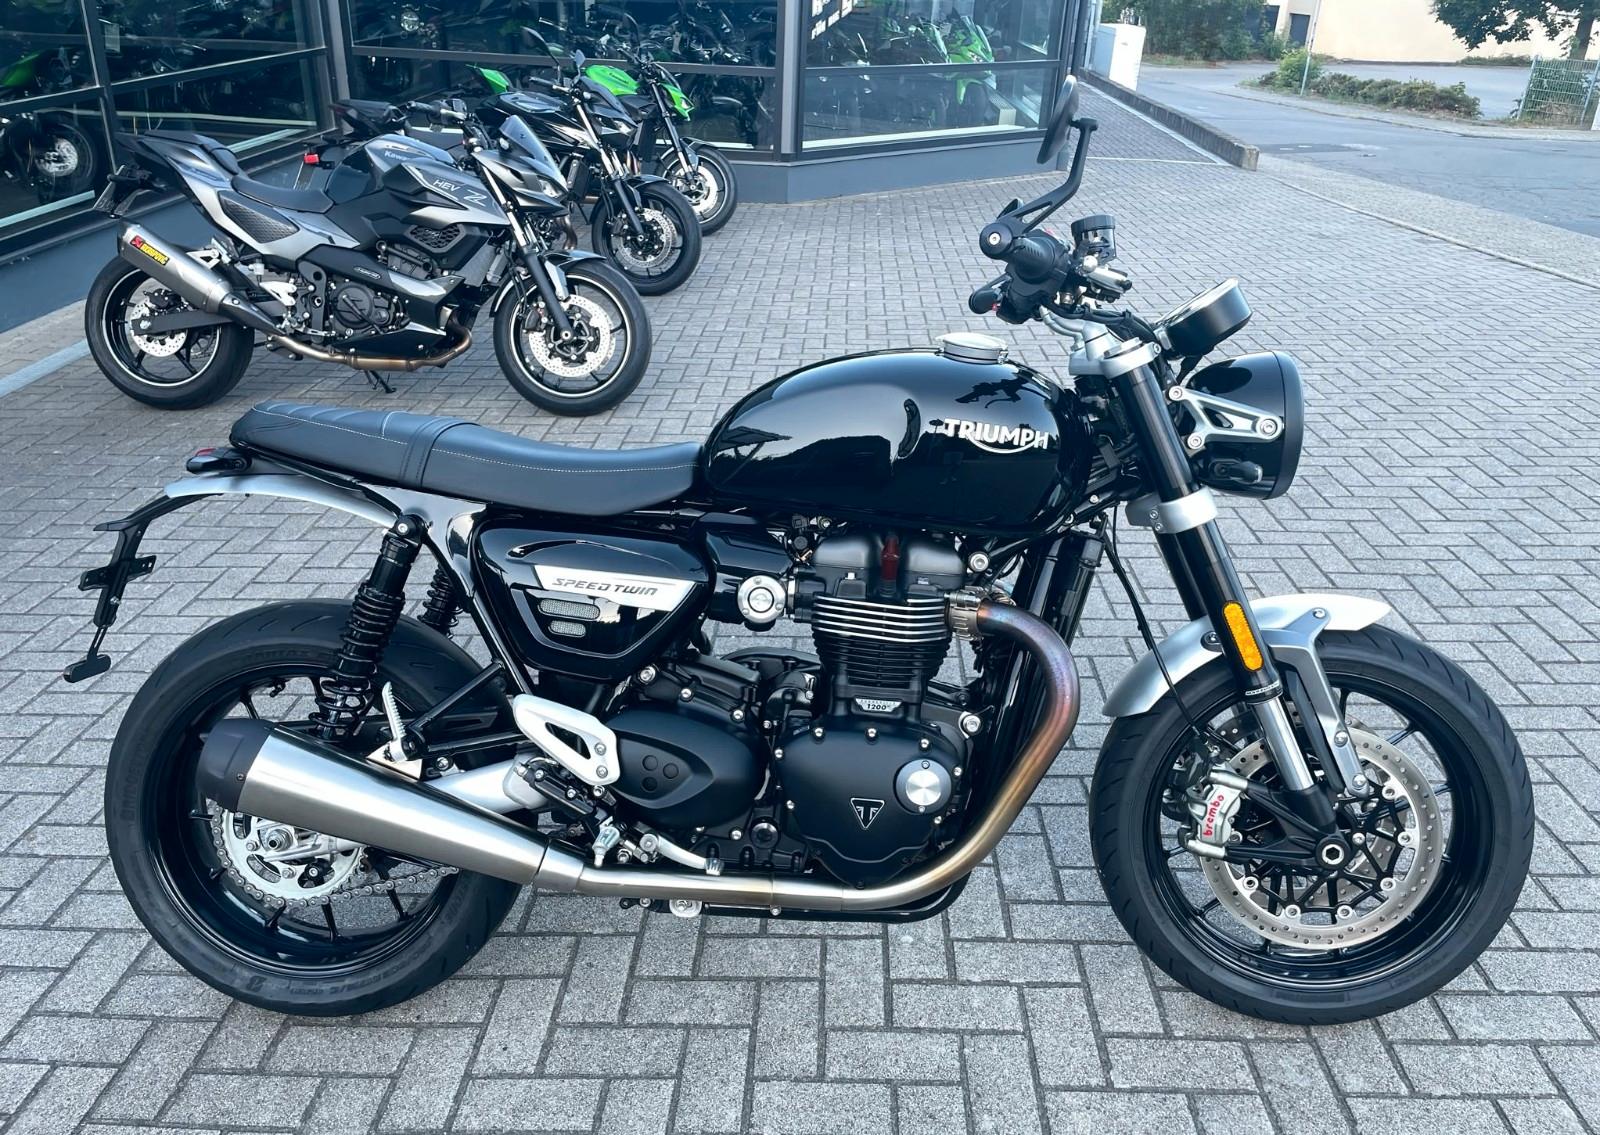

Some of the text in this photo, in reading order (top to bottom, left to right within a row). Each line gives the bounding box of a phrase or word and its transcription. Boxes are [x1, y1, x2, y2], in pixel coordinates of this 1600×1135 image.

[432, 179, 461, 192] HEV
[944, 418, 1049, 453] TRIUMPH
[551, 577, 659, 596] SPEED TWIN
[1202, 794, 1225, 837] brembo
